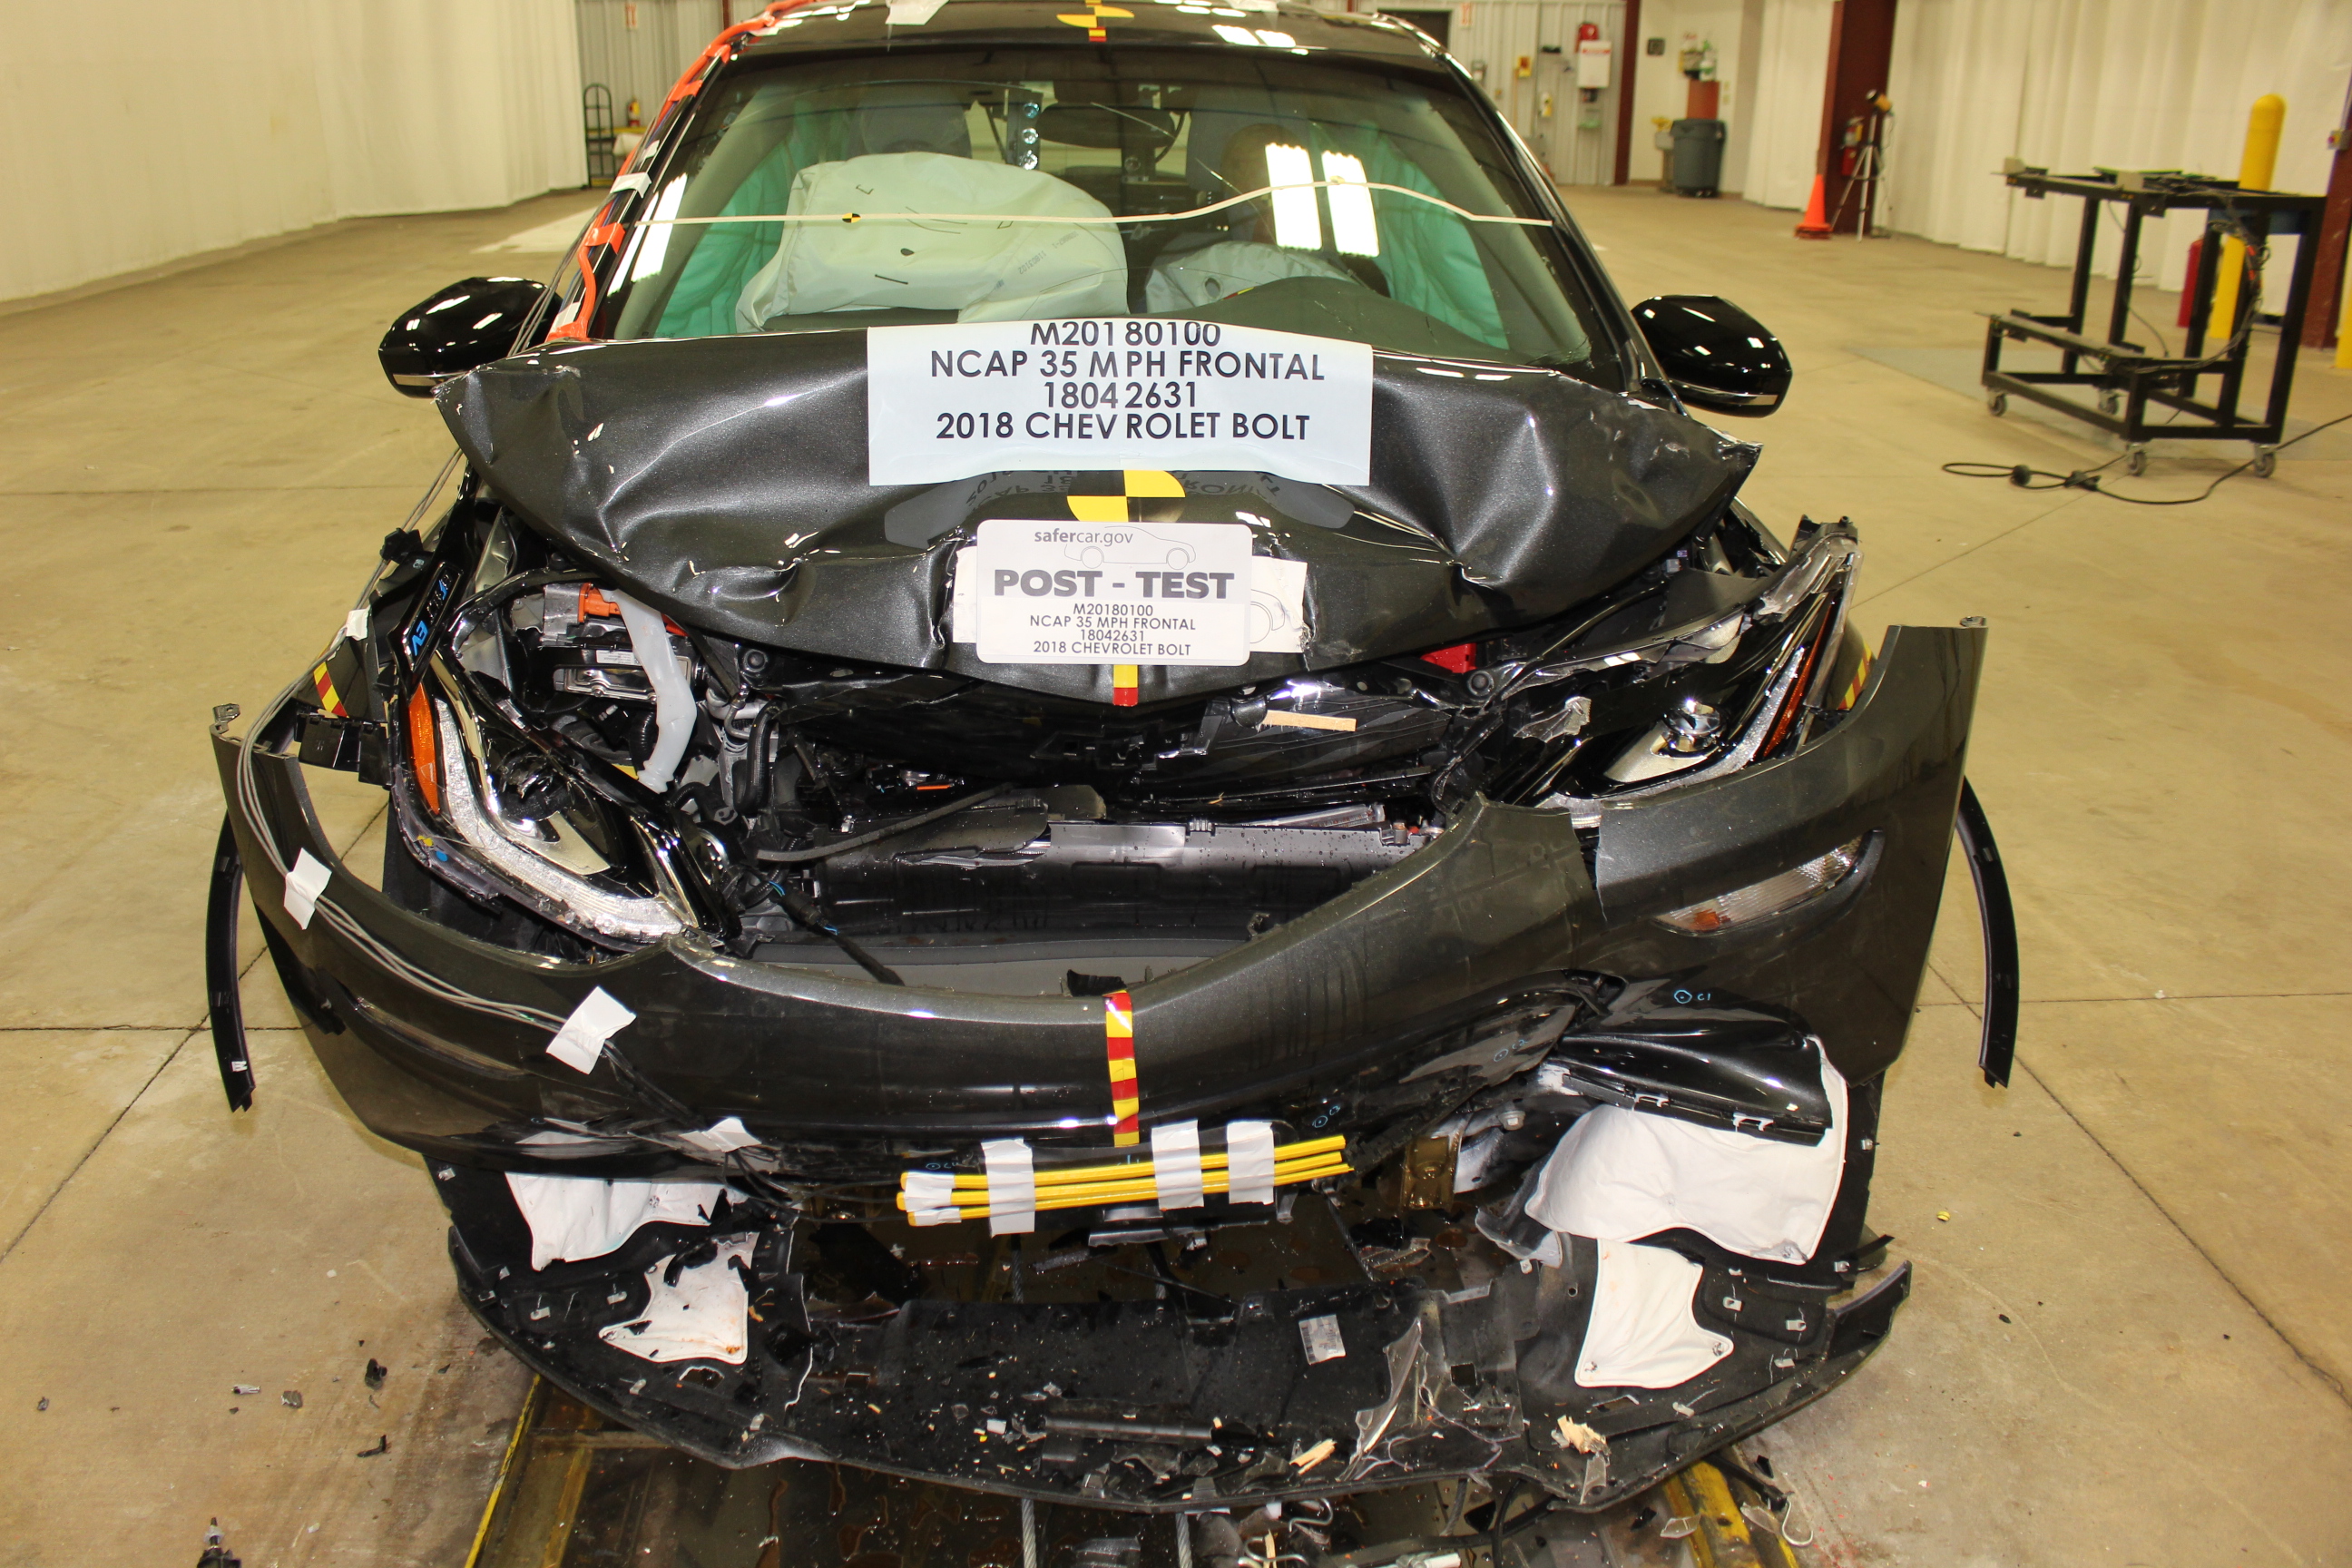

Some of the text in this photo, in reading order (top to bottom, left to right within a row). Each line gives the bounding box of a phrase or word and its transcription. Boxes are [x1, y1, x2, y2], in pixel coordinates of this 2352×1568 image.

[1030, 320, 1221, 348] M20180100
[931, 349, 1325, 381] NCAP 35 MPH FRONTAL
[1044, 381, 1195, 409] 18042631
[936, 411, 1310, 440] 2018 CHEVROLET BOLT
[1034, 527, 1133, 547] safercar.gov
[995, 569, 1103, 597] POST
[1135, 571, 1235, 599] TEST
[1073, 603, 1153, 617] M20180100
[1030, 614, 1196, 631] NCAP 35 MPH FRONTAL
[1081, 629, 1144, 642] 18042631
[1033, 641, 1191, 656] 2018 CHEVROLET BOLT
